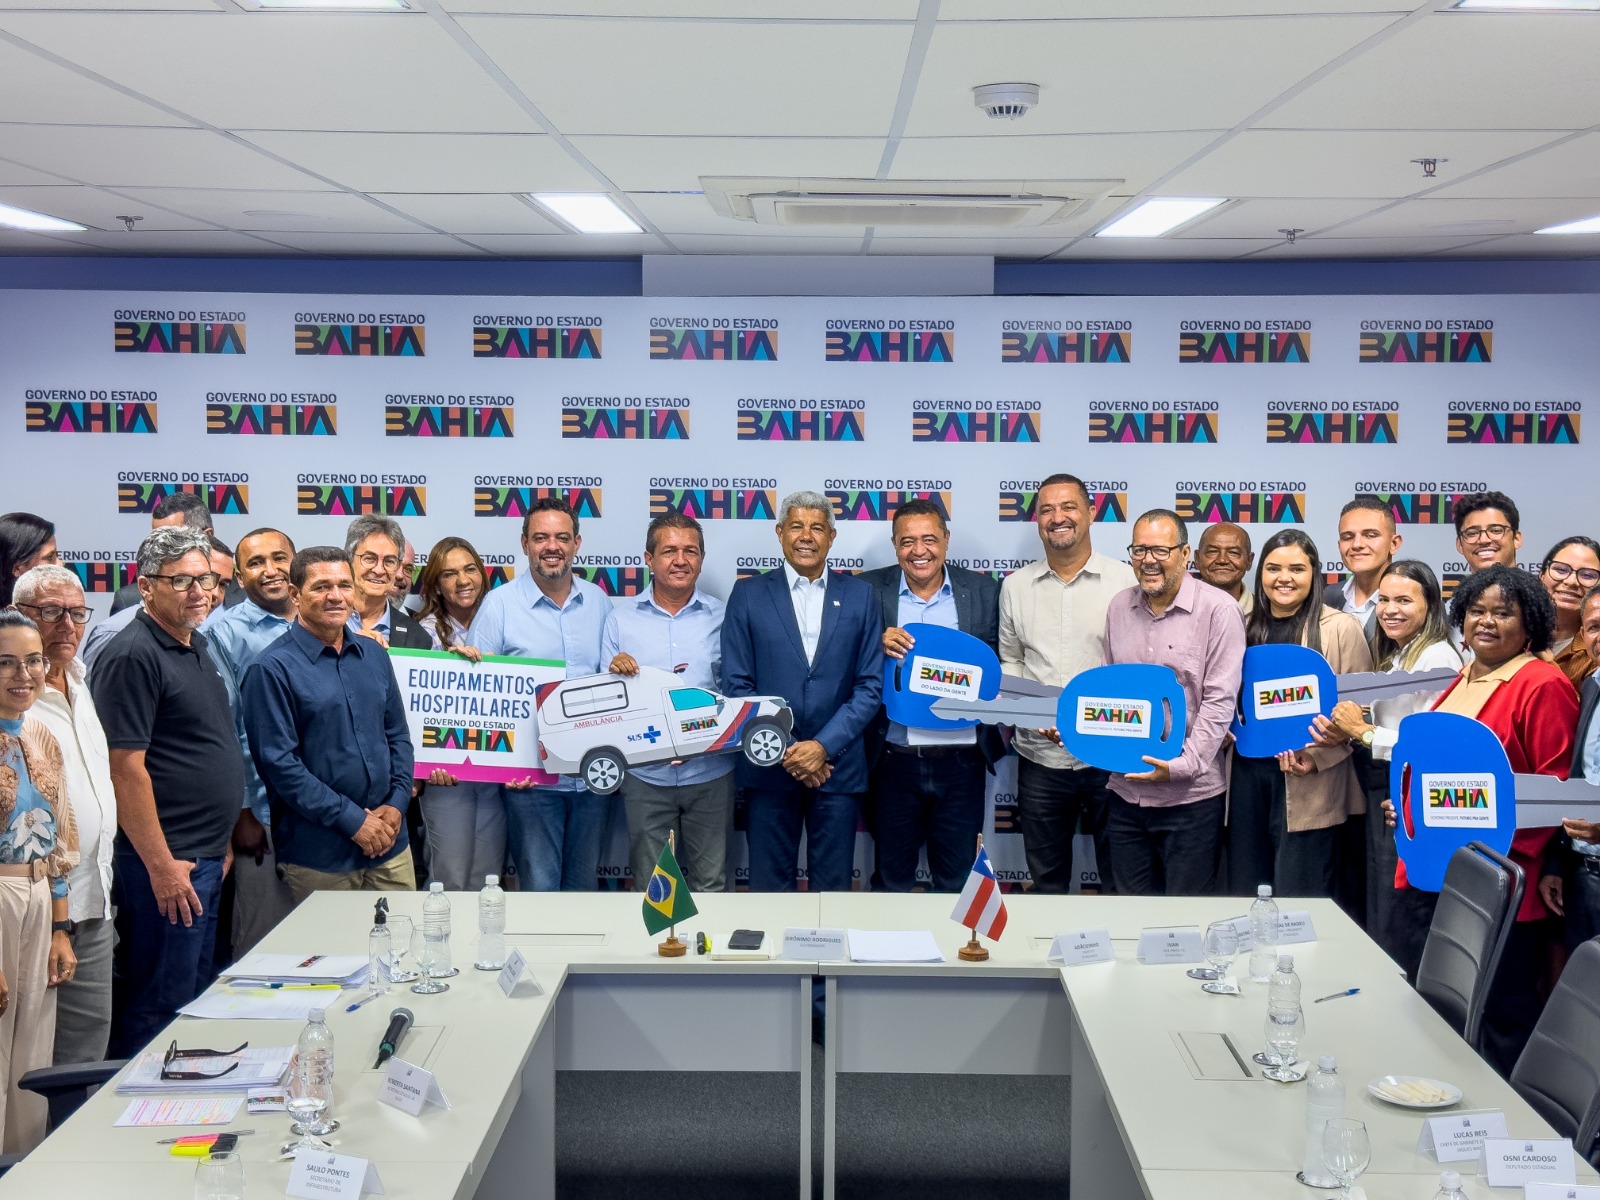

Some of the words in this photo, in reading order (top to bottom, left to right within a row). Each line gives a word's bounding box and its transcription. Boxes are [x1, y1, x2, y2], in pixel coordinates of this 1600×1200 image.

[114, 310, 175, 321] GOVERNO
[179, 311, 196, 321] DO
[200, 312, 246, 322] ESTADO
[294, 312, 355, 323] GOVERNO
[358, 314, 376, 324] DO
[379, 314, 425, 324] ESTADO
[473, 316, 532, 326] GOVERNO
[536, 316, 553, 326] DO
[557, 316, 602, 326] ESTADO
[650, 318, 709, 328] GOVERNO
[713, 318, 730, 328] DO
[733, 318, 778, 329] ESTADO
[826, 320, 885, 330] GOVERNO
[889, 320, 906, 330] DO
[909, 320, 954, 330] ESTADO
[1002, 320, 1061, 330] GOVERNO
[1066, 321, 1082, 330] DO
[1086, 320, 1132, 331] ESTADO
[1180, 320, 1240, 330] GOVERNO
[1244, 320, 1262, 330] DO
[1265, 320, 1311, 330] ESTADO
[1360, 320, 1421, 330] GOVERNO
[1425, 320, 1443, 330] DO
[1447, 320, 1494, 330] ESTADO
[115, 323, 245, 354] BAHIA
[295, 325, 425, 356] BAHIA
[474, 328, 602, 359] BAHIA
[650, 330, 778, 361] BAHIA
[826, 331, 954, 362] BAHIA
[1002, 332, 1132, 364] BAHIA
[1180, 332, 1310, 364] BAHIA
[1360, 332, 1493, 363] BAHIA
[25, 390, 86, 400] GOVERNO
[90, 390, 107, 401] DO
[111, 391, 157, 401] ESTADO
[206, 392, 266, 403] GOVERNO
[270, 393, 287, 403] DO
[291, 393, 337, 404] ESTADO
[385, 394, 444, 405] GOVERNO
[448, 395, 465, 406] DO
[469, 396, 514, 406] ESTADO
[562, 396, 621, 407] GOVERNO
[624, 397, 641, 407] DO
[645, 398, 690, 408] ESTADO
[738, 398, 796, 409] GOVERNO
[800, 399, 817, 410] DO
[820, 400, 865, 410] ESTADO
[913, 400, 972, 410] GOVERNO
[976, 400, 992, 410] DO
[996, 401, 1041, 411] ESTADO
[1089, 401, 1148, 411] GOVERNO
[1152, 401, 1170, 411] DO
[1173, 401, 1219, 411] ESTADO
[1267, 401, 1328, 411] GOVERNO
[1332, 401, 1349, 411] DO
[1353, 401, 1399, 411] ESTADO
[1448, 401, 1510, 412] GOVERNO
[1513, 401, 1530, 412] DO
[1535, 401, 1581, 412] ESTADO
[26, 402, 158, 433] BAHIA
[206, 404, 337, 436] BAHIA
[386, 406, 514, 438] BAHIA
[562, 408, 690, 440] BAHIA
[738, 410, 865, 442] BAHIA
[913, 412, 1041, 443] BAHIA
[1089, 412, 1218, 444] BAHIA
[1267, 412, 1399, 444] BAHIA
[1448, 412, 1581, 444] BAHIA
[118, 472, 178, 482] GOVERNO
[182, 472, 199, 482] DO
[203, 472, 248, 483] ESTADO
[297, 474, 356, 484] GOVERNO
[360, 474, 378, 484] DO
[382, 474, 426, 484] ESTADO
[474, 476, 533, 486] GOVERNO
[537, 476, 554, 486] DO
[558, 476, 602, 486] ESTADO
[650, 478, 708, 488] GOVERNO
[712, 478, 729, 488] DO
[732, 478, 777, 488] ESTADO
[824, 479, 883, 490] GOVERNO
[887, 480, 904, 490] DO
[907, 480, 952, 490] ESTADO
[1000, 480, 1042, 490] GOVER
[1176, 482, 1236, 492] GOVERNO
[1240, 482, 1256, 492] DO
[1260, 482, 1306, 492] ESTADO
[1355, 482, 1415, 492] GOVERNO
[1420, 482, 1436, 492] DO
[1440, 482, 1487, 492] ESTADO
[298, 485, 427, 517] BAHIA
[650, 489, 777, 520] BAHIA
[1176, 492, 1306, 524] BAHIA
[94, 551, 110, 560] DO
[482, 555, 514, 564] STADO
[574, 555, 620, 565] OVERNO
[624, 556, 641, 565] DO
[737, 557, 784, 567] GOVERN
[827, 558, 863, 567] STADO
[973, 560, 989, 569] DO
[1327, 562, 1344, 571] DO
[408, 668, 535, 695] EQUIPAMENTOS
[920, 667, 972, 687] BAHIA
[1260, 685, 1313, 705] BAHIA
[410, 693, 530, 719] HOSPITALARES
[574, 715, 623, 729] AMBULÂNCIA
[1084, 708, 1143, 724] BAHIA
[424, 717, 466, 727] GOVERNO
[483, 721, 515, 729] ESTADO
[681, 718, 718, 732] BAHIA
[422, 726, 514, 752] BAHIA
[627, 734, 642, 742] SUS
[1430, 788, 1488, 808] BAHIA
[306, 1164, 326, 1173] SAULO
[327, 1168, 350, 1178] PONTES
